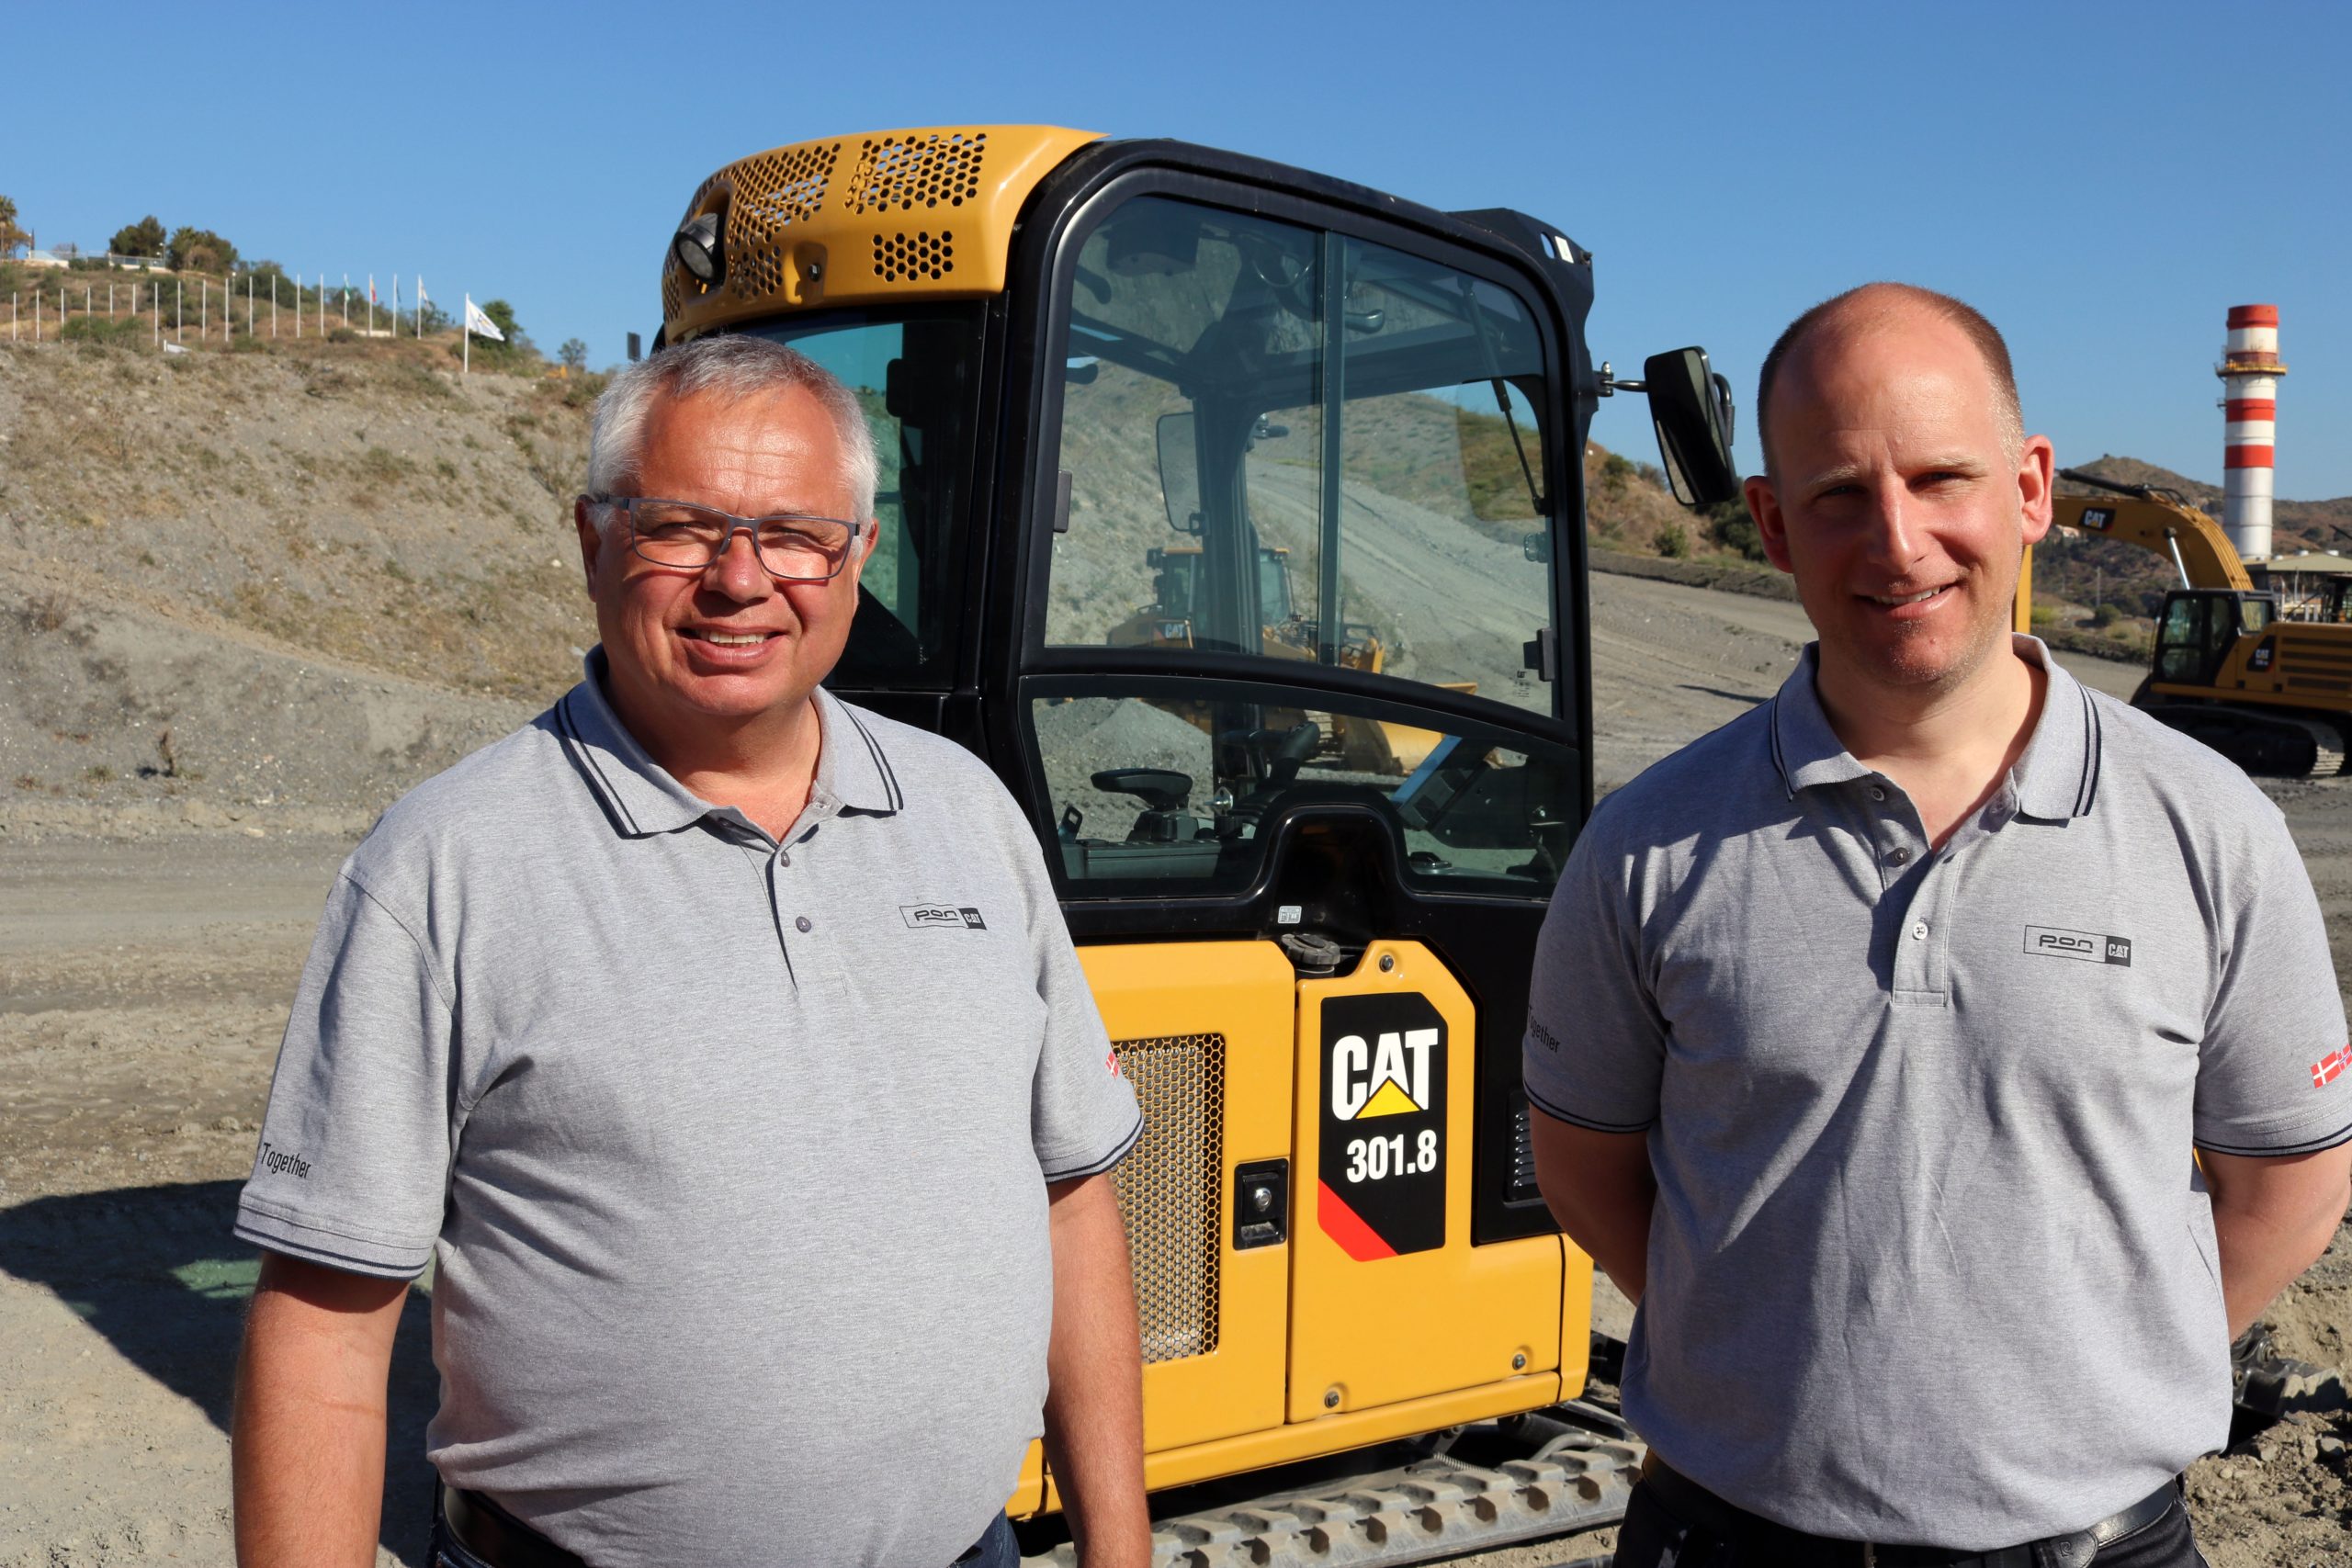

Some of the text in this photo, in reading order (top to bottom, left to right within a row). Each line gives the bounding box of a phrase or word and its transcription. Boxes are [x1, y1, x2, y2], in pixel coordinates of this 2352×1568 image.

[2085, 510, 2106, 528] CAT
[1165, 624, 1184, 638] CAT
[963, 913, 981, 924] CAT
[2108, 943, 2130, 959] CAT
[1332, 1028, 1439, 1121] CAT
[261, 1142, 311, 1179] Together
[1346, 1129, 1437, 1183] 301.8
